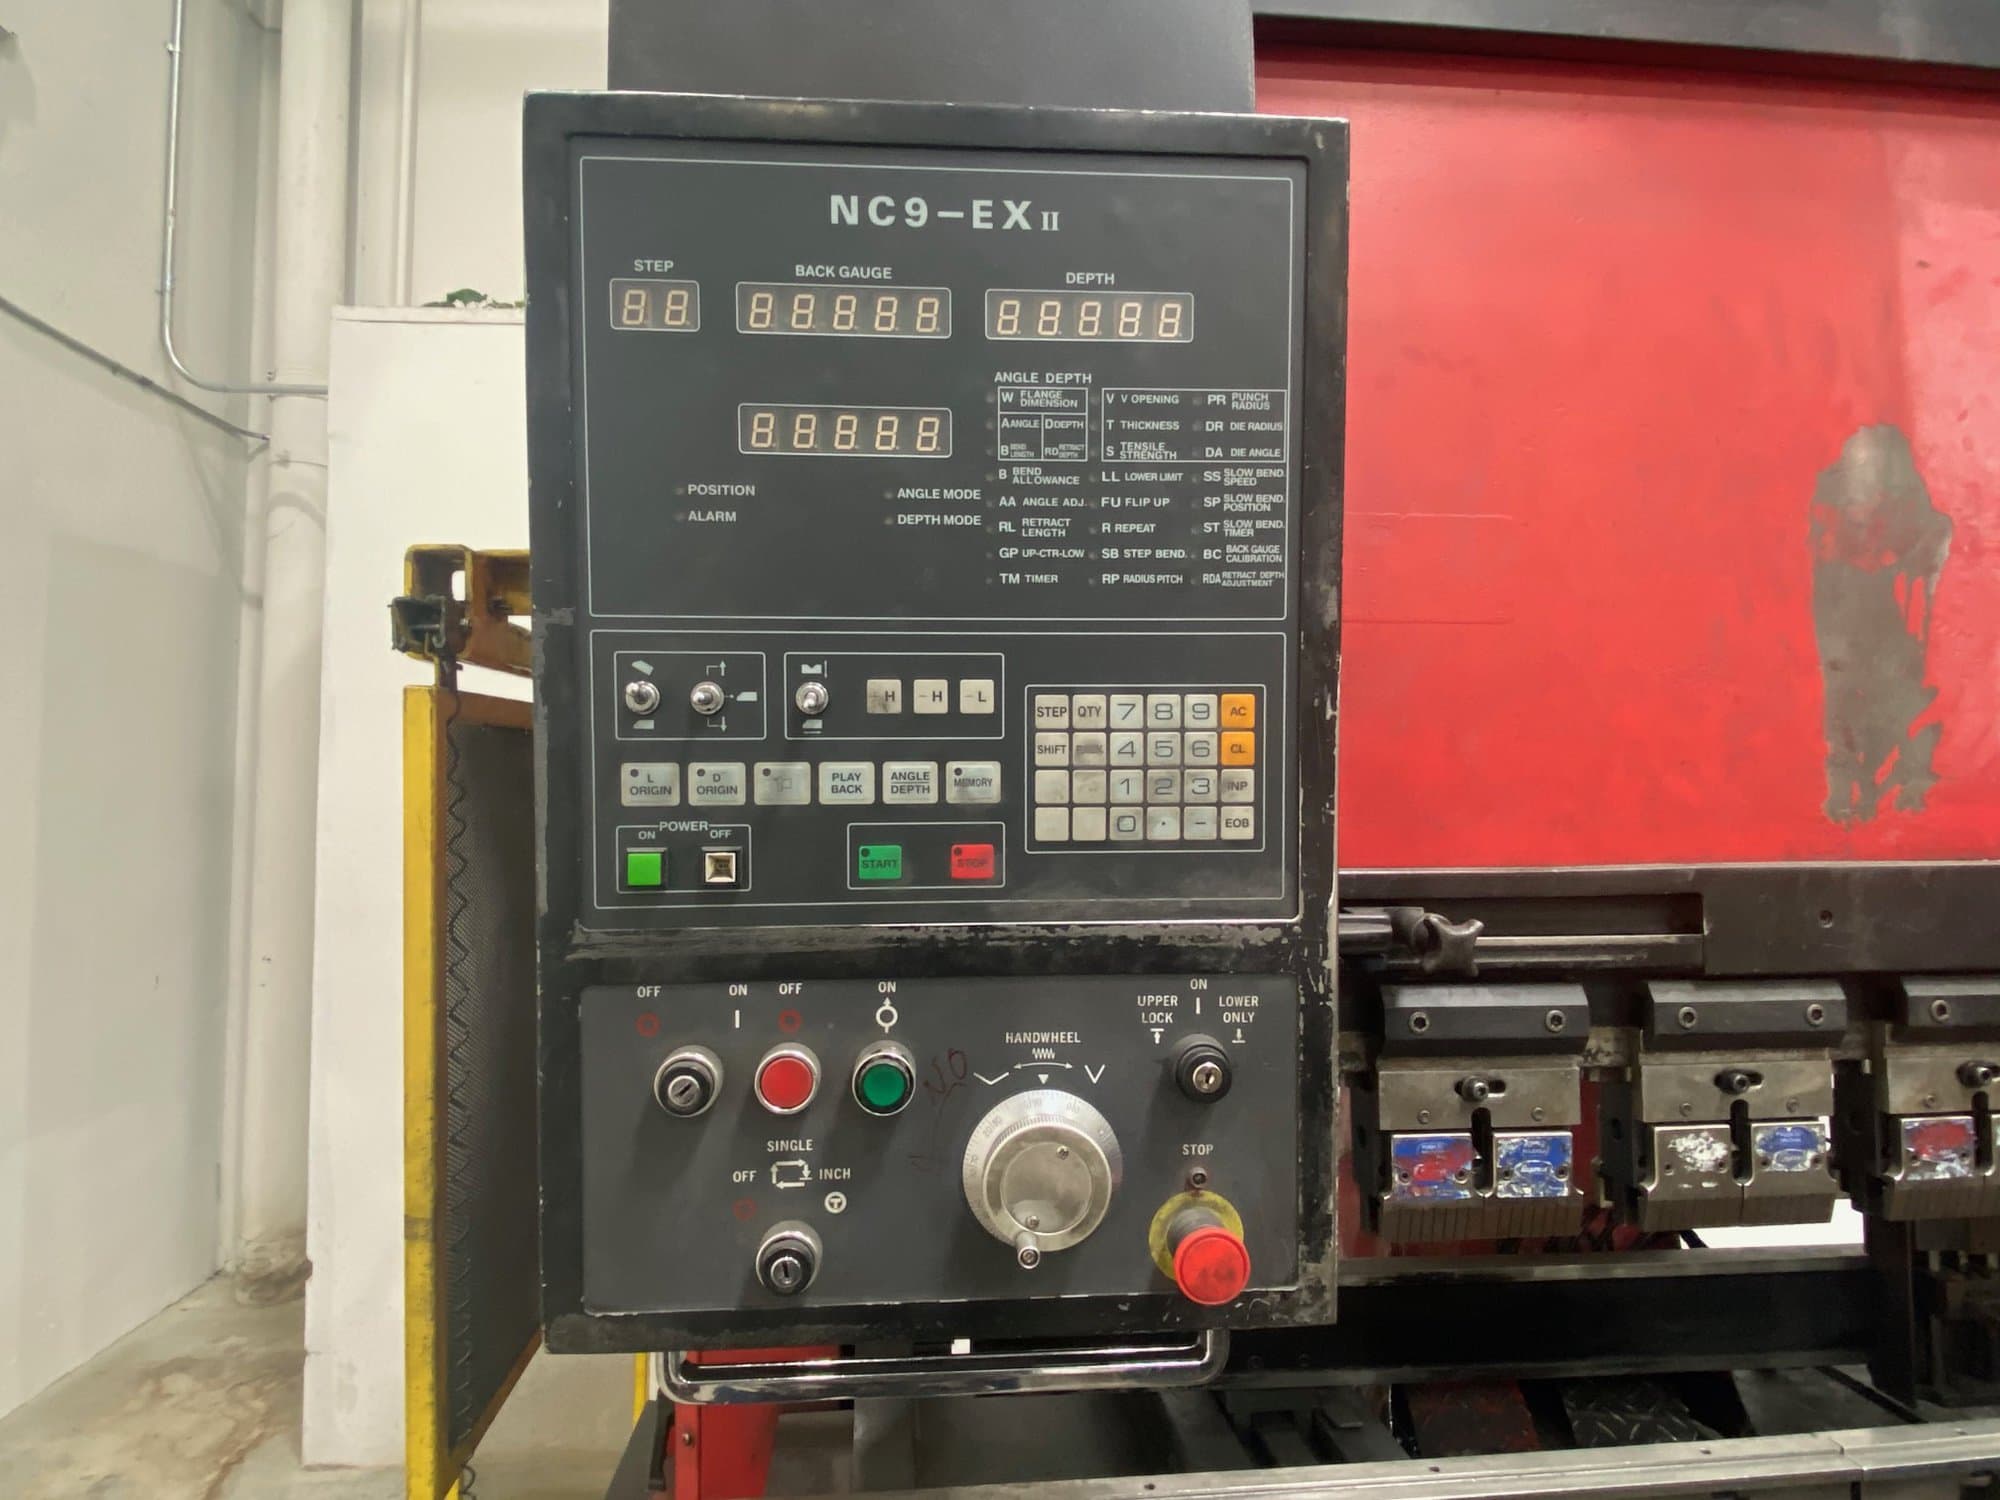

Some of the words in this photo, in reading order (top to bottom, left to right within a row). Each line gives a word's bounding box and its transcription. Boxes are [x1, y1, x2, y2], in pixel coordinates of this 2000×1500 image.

[634, 260, 674, 272] STEP
[795, 265, 835, 278] BACK
[839, 266, 892, 279] GAUGE
[1066, 272, 1115, 285] DEPTH
[994, 372, 1039, 384] ANGLE
[1045, 373, 1092, 385] DEPTH
[1001, 392, 1014, 403] W
[1020, 390, 1063, 399] FLANGE
[1106, 393, 1114, 404] V
[1121, 394, 1128, 403] V
[1131, 394, 1179, 404] OPENING
[1207, 394, 1226, 405] PR
[1231, 392, 1269, 401] PUNCH
[1020, 399, 1078, 408] DIMENSION
[1231, 401, 1270, 410] RADIUS
[1010, 419, 1040, 428] ANGLE
[1054, 420, 1084, 429] DEPTH
[1106, 419, 1114, 430] T
[1120, 420, 1180, 430] THICKNESS
[1205, 421, 1224, 432] DR
[1230, 422, 1246, 431] DIE
[1247, 422, 1283, 431] RADIUS
[1000, 445, 1009, 456] B
[1044, 447, 1059, 456] RD
[1106, 445, 1114, 457] S
[1120, 441, 1166, 451] TENSILE
[1120, 451, 1177, 460] STRENGTH
[1205, 447, 1223, 457] DA
[1230, 448, 1247, 457] DIE
[1248, 448, 1281, 457] ANGLE
[999, 468, 1007, 479] B
[1012, 467, 1042, 476] BEND
[1101, 471, 1120, 482] LL
[1124, 472, 1157, 481] LOWER
[1159, 472, 1184, 481] LIMIT
[1203, 471, 1221, 482] SS
[1223, 468, 1253, 477] SLOW
[1012, 475, 1080, 485] ALLOWANCE
[1223, 477, 1257, 486] SPEED
[687, 484, 756, 497] POSITION
[897, 488, 940, 499] ANGLE
[943, 489, 982, 500] MODE
[999, 496, 1016, 507] AA
[1022, 497, 1059, 507] ANGLE
[1101, 496, 1121, 508] FU
[1125, 497, 1151, 507] FLIP
[1153, 497, 1170, 507] UP
[1203, 496, 1221, 508] SP
[1223, 494, 1253, 503] SLOW
[1223, 503, 1271, 512] POSITION
[688, 510, 737, 523] ALARM
[897, 514, 940, 525] DEPTH
[943, 515, 982, 525] MODE
[998, 521, 1016, 533] RL
[1022, 518, 1072, 527] RETRACT
[1102, 522, 1111, 533] R
[1115, 523, 1156, 533] REPEAT
[1203, 522, 1221, 533] ST
[1223, 519, 1253, 529] SLOW
[1022, 528, 1066, 537] LENGTH
[1223, 528, 1254, 537] TIMER
[999, 547, 1019, 559] GP
[1022, 549, 1085, 558] UP-CTR-LOW
[1102, 548, 1119, 559] SB
[1123, 548, 1152, 558] STEP
[1203, 549, 1222, 560] BC
[1226, 544, 1250, 554] BACK
[1250, 545, 1280, 554] GAUGE
[1226, 554, 1282, 563] CALIBRATION
[999, 573, 1020, 584] TM
[1024, 574, 1058, 584] TIMER
[1102, 573, 1120, 584] RP
[1123, 574, 1155, 584] RADIUS
[1156, 574, 1183, 584] PITCH
[1202, 573, 1221, 584] RDA
[1222, 571, 1256, 579] RETRACT
[1260, 571, 1285, 579] DEPTH
[1221, 579, 1272, 587] ADJUSTMENT
[1036, 706, 1067, 717] STEP
[1077, 706, 1102, 717] QTY
[1117, 703, 1136, 720] 7
[1154, 703, 1174, 720] 8
[1191, 703, 1210, 720] 9
[1230, 707, 1247, 716] AC
[1036, 744, 1067, 755] SHIFT
[1117, 740, 1136, 757] 4
[1154, 741, 1174, 758] 5
[1191, 740, 1210, 757] 6
[1230, 744, 1246, 754] CL
[647, 773, 654, 784] L
[713, 772, 721, 784] D
[832, 772, 862, 783] PLAY
[890, 771, 930, 782] ANGLE
[954, 778, 993, 788] MEMORY
[1119, 778, 1130, 795] 1
[1155, 778, 1174, 795] 2
[1191, 778, 1210, 795] 3
[629, 785, 672, 797] ORIGIN
[696, 784, 739, 796] ORIGIN
[831, 783, 863, 795] BACK
[890, 784, 931, 795] DEPTH
[659, 820, 709, 832] POWER
[1116, 815, 1136, 832] 0
[1225, 818, 1249, 828] EOB
[638, 830, 656, 840] ON
[709, 829, 732, 839] OFF
[861, 858, 898, 870] START
[779, 983, 803, 995] OFF
[878, 981, 897, 993] ON
[1190, 978, 1207, 991] ON
[637, 986, 662, 998] OFF
[729, 985, 748, 997] ON
[1137, 995, 1178, 1007] UPPER
[1218, 995, 1259, 1008] LOWER
[1141, 1012, 1173, 1024] LOCK
[1223, 1012, 1255, 1024] ONLY
[1005, 1031, 1081, 1044] HANDWHEEL
[767, 1139, 813, 1152] SINGLE
[1182, 1144, 1214, 1155] STOP
[732, 1170, 757, 1183] OFF
[819, 1167, 851, 1180] INCH
